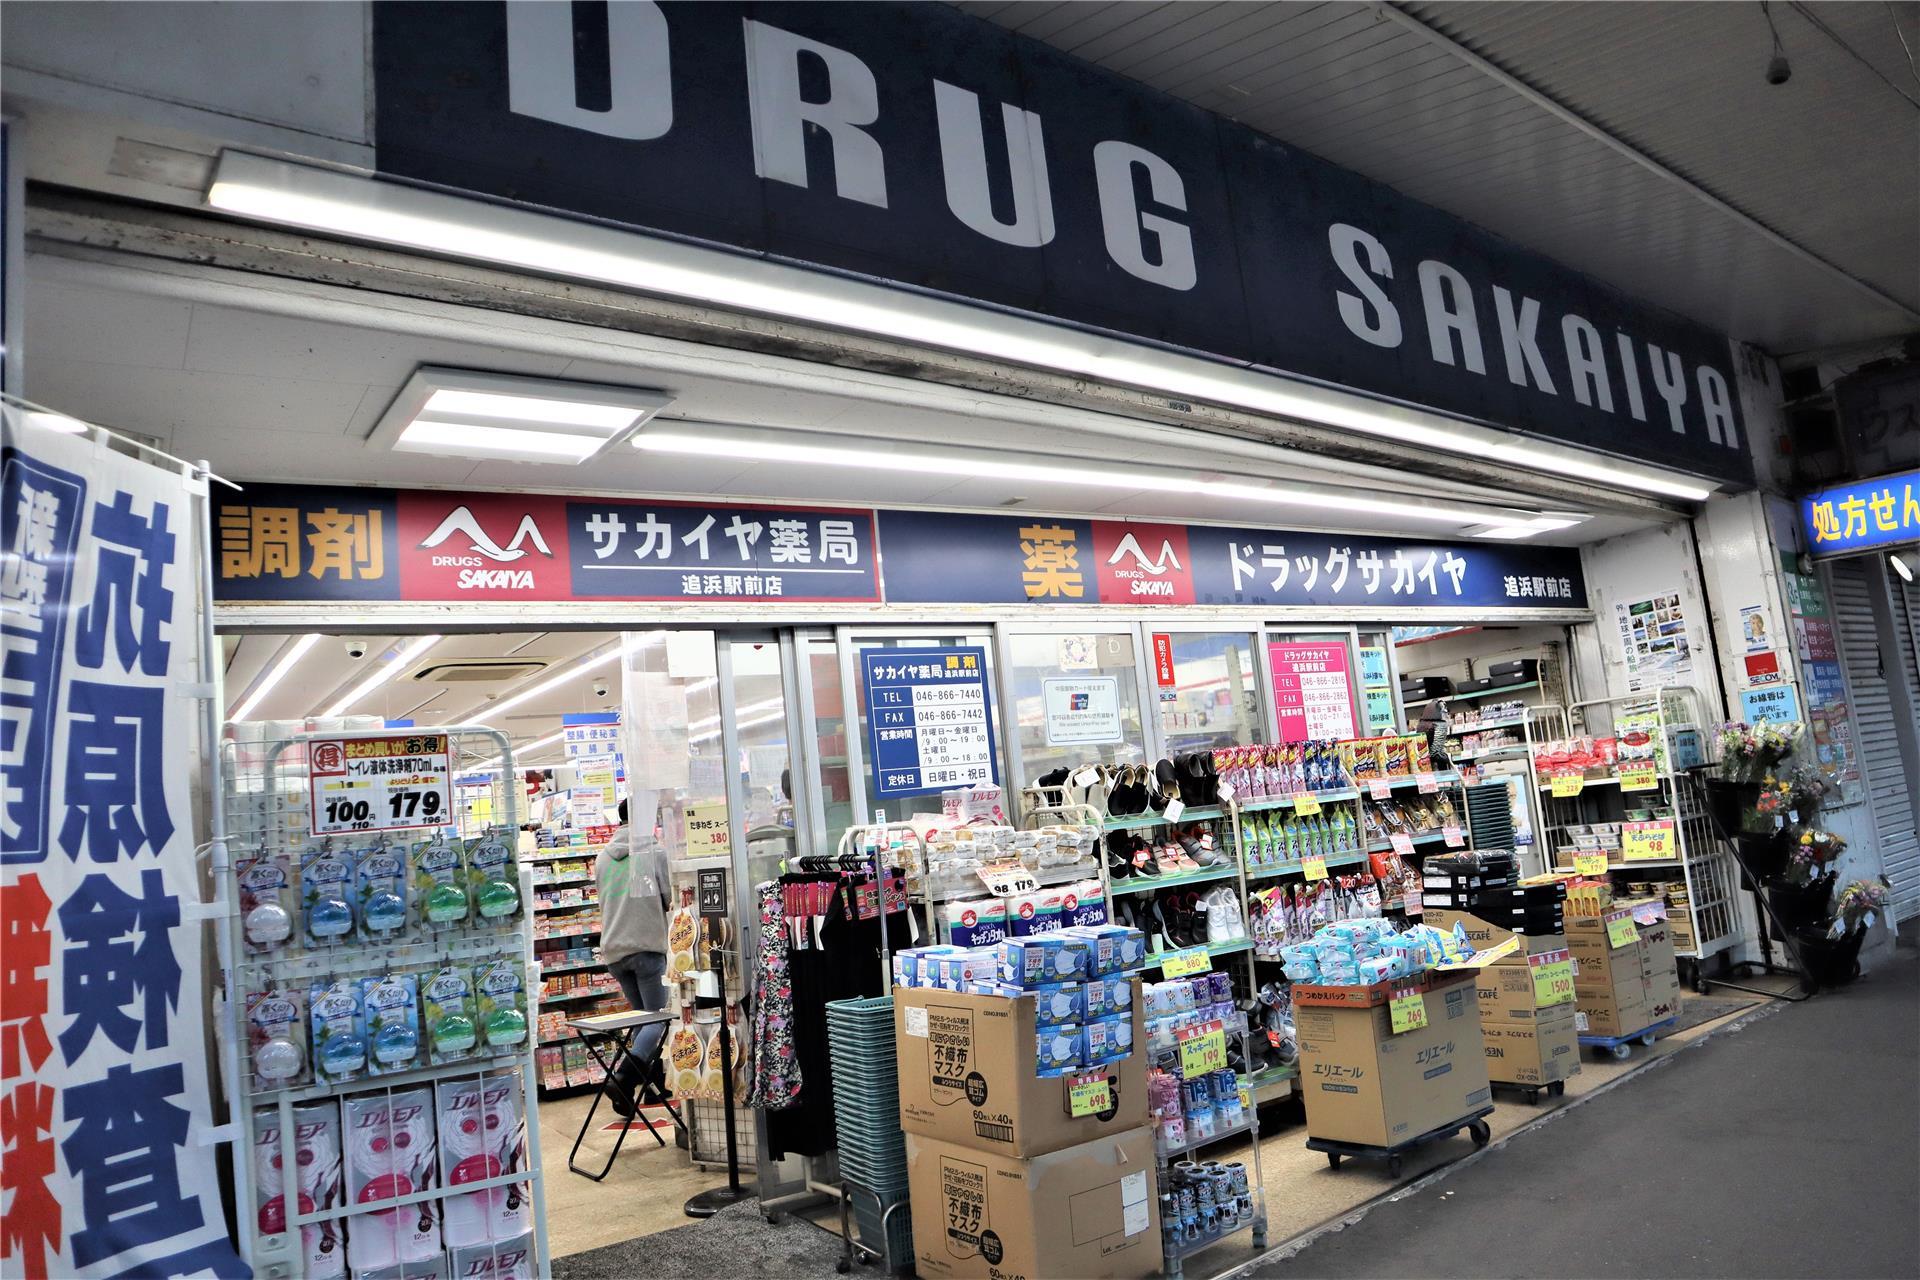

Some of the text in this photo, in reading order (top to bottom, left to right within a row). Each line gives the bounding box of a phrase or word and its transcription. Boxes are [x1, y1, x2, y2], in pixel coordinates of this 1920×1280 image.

[507, 0, 1738, 450] DRUG SAKAIYA
[1812, 484, 1920, 544] 処方せん
[218, 505, 384, 580] 調剤
[585, 512, 858, 565] サカイヤ薬局
[432, 556, 482, 567] DRUGS
[1019, 524, 1084, 598] 薬
[1229, 542, 1466, 595] ドラッグサカイヤ
[457, 569, 535, 589] SAKAIYA
[1115, 570, 1144, 579] DRUGS
[682, 574, 783, 596] 追浜駅前店
[1131, 581, 1174, 596] SAKAIYA
[1504, 575, 1572, 599] 追浜駅前店
[1284, 650, 1329, 660] ドラッグサカイヤ
[874, 664, 943, 680] サカイヤ薬局
[1749, 672, 1779, 685] SECOM
[1281, 678, 1294, 687] TEL
[883, 692, 902, 703] TEL
[916, 688, 981, 701] 046-866-7440
[1283, 694, 1297, 703] FAX
[1749, 691, 1785, 703] お線香は
[885, 712, 905, 723] FAX
[918, 709, 983, 722] 046-866-7442
[880, 729, 913, 741] 営業時間
[888, 775, 915, 787] 定休日
[690, 820, 713, 830] たまねぎ
[710, 832, 727, 844] 380
[1631, 833, 1665, 842] 天ぷらそば
[1648, 841, 1663, 852] 98
[1186, 958, 1201, 969] 880
[1551, 979, 1570, 994] 1500
[1305, 991, 1346, 1000] つめかえパック
[1407, 1009, 1422, 1024] 269
[1188, 1023, 1213, 1038] 特売品
[934, 1045, 968, 1063] 不織布
[1203, 1049, 1219, 1066] 199
[1415, 1040, 1455, 1064] エリエール
[934, 1061, 965, 1078] マスク
[1312, 1063, 1364, 1079] エリエール
[1090, 1093, 1106, 1108] 698
[256, 1121, 327, 1146] エモア
[949, 1197, 983, 1220] 不織布
[949, 1213, 980, 1233] マスク
